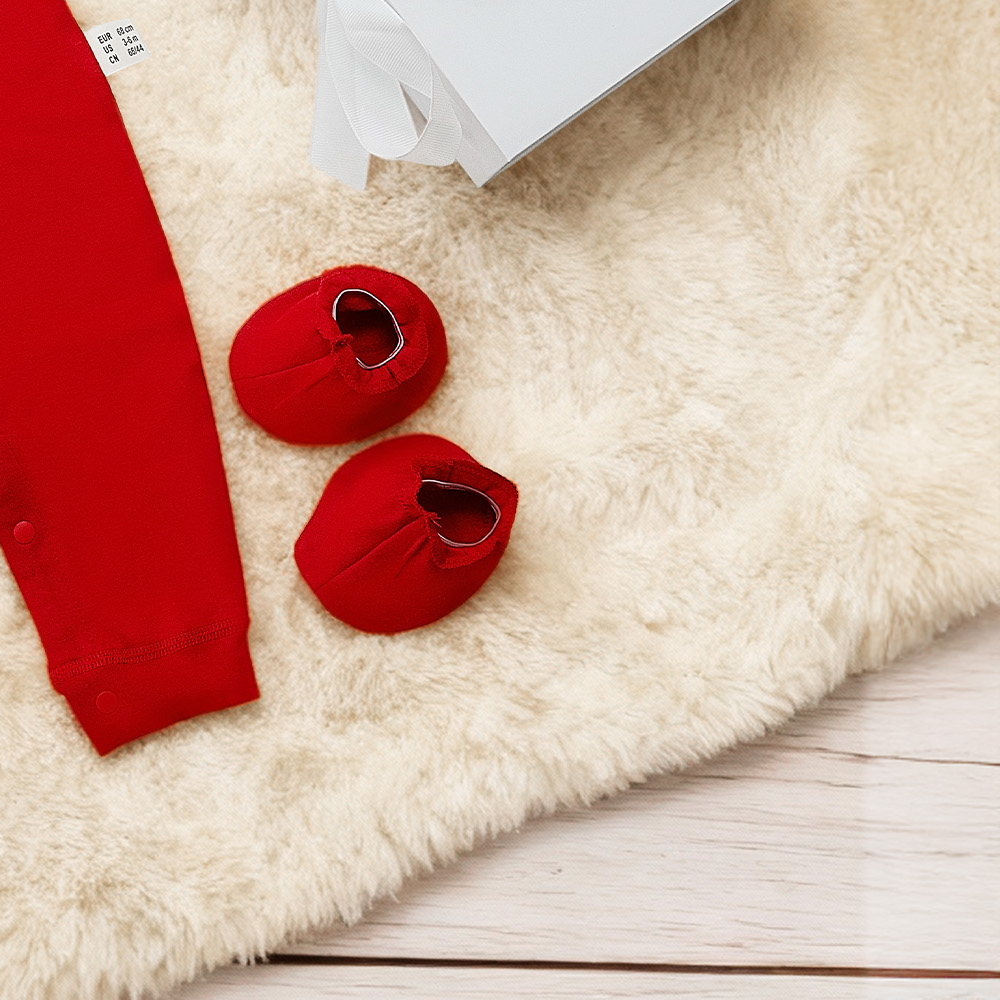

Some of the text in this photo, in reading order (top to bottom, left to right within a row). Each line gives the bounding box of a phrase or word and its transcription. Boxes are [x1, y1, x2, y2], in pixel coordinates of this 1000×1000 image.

[97, 32, 113, 44] EUR
[102, 44, 114, 54] US
[108, 54, 120, 64] CN
